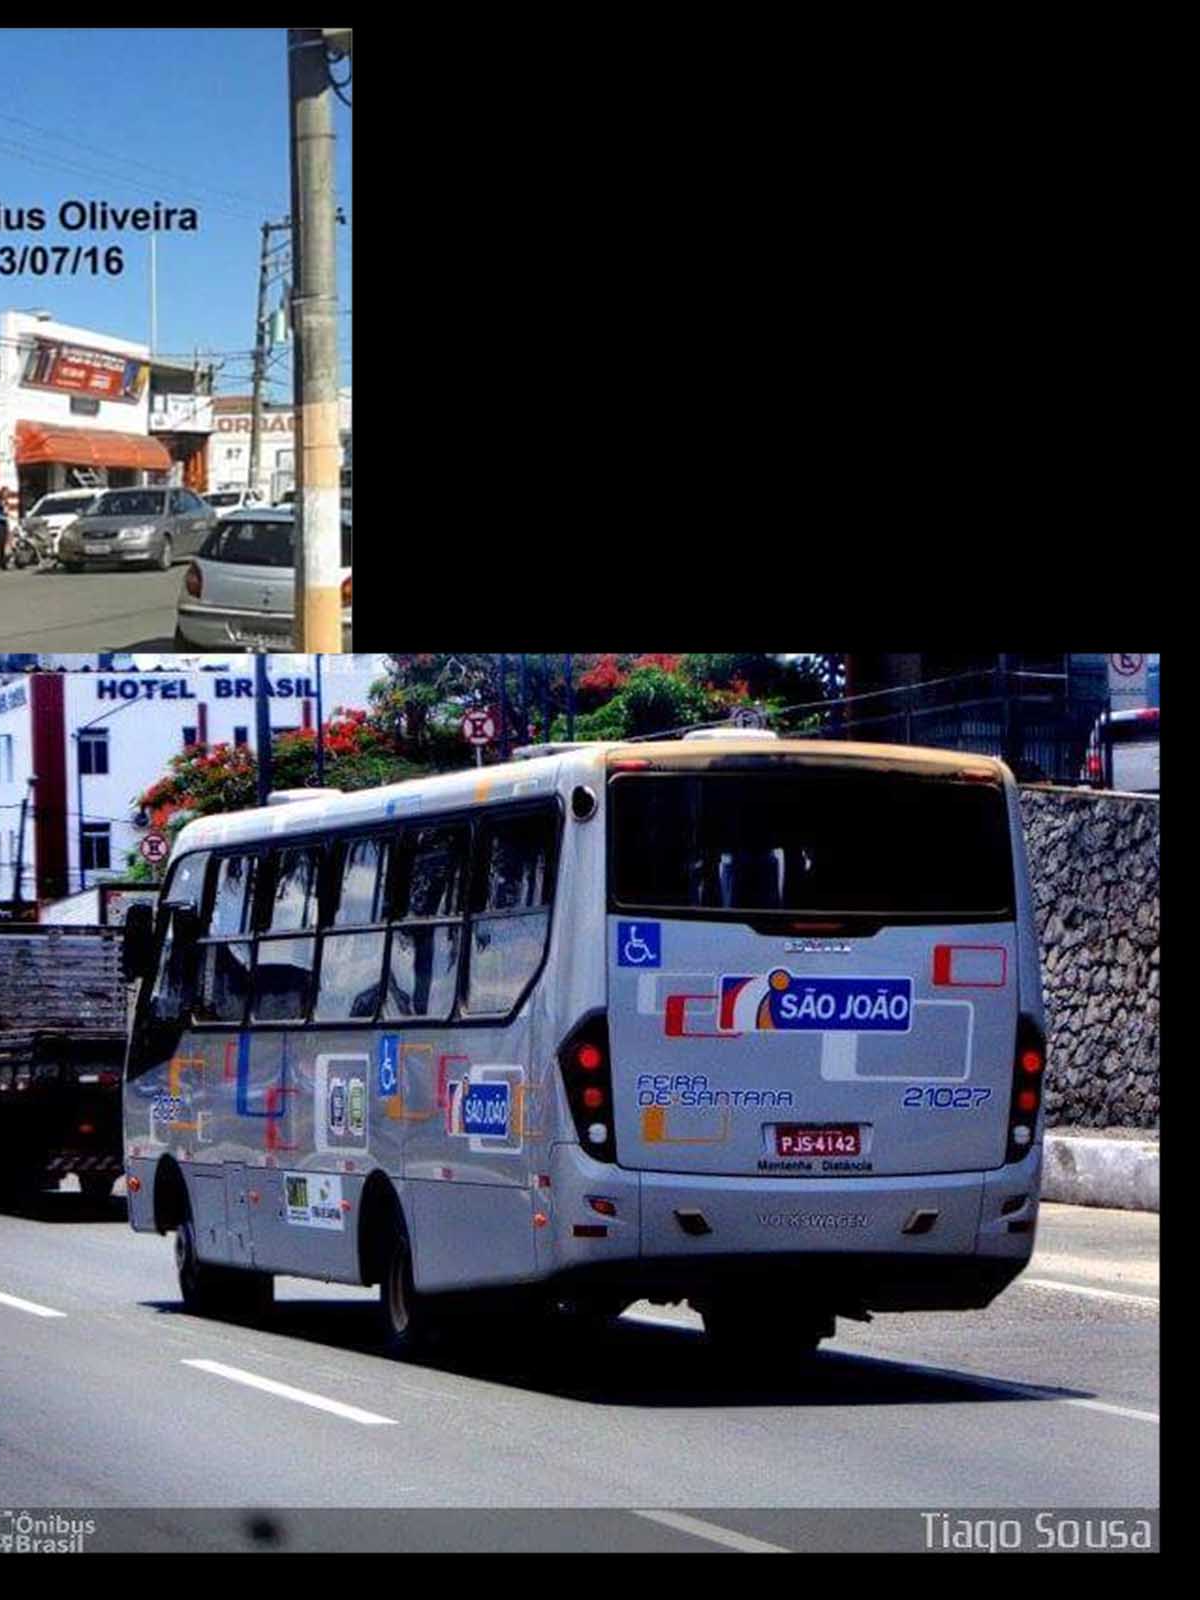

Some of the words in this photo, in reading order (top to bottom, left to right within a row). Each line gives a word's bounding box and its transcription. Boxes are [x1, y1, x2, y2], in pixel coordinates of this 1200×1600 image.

[97, 678, 196, 700] HOTEL
[214, 677, 319, 699] BRASIL
[779, 987, 836, 1019] SÃO
[839, 988, 909, 1020] JOÃO
[638, 1074, 709, 1090] FEIRA
[638, 1089, 673, 1107] DE
[680, 1090, 794, 1107] SANTANA
[903, 1087, 992, 1108] 21027
